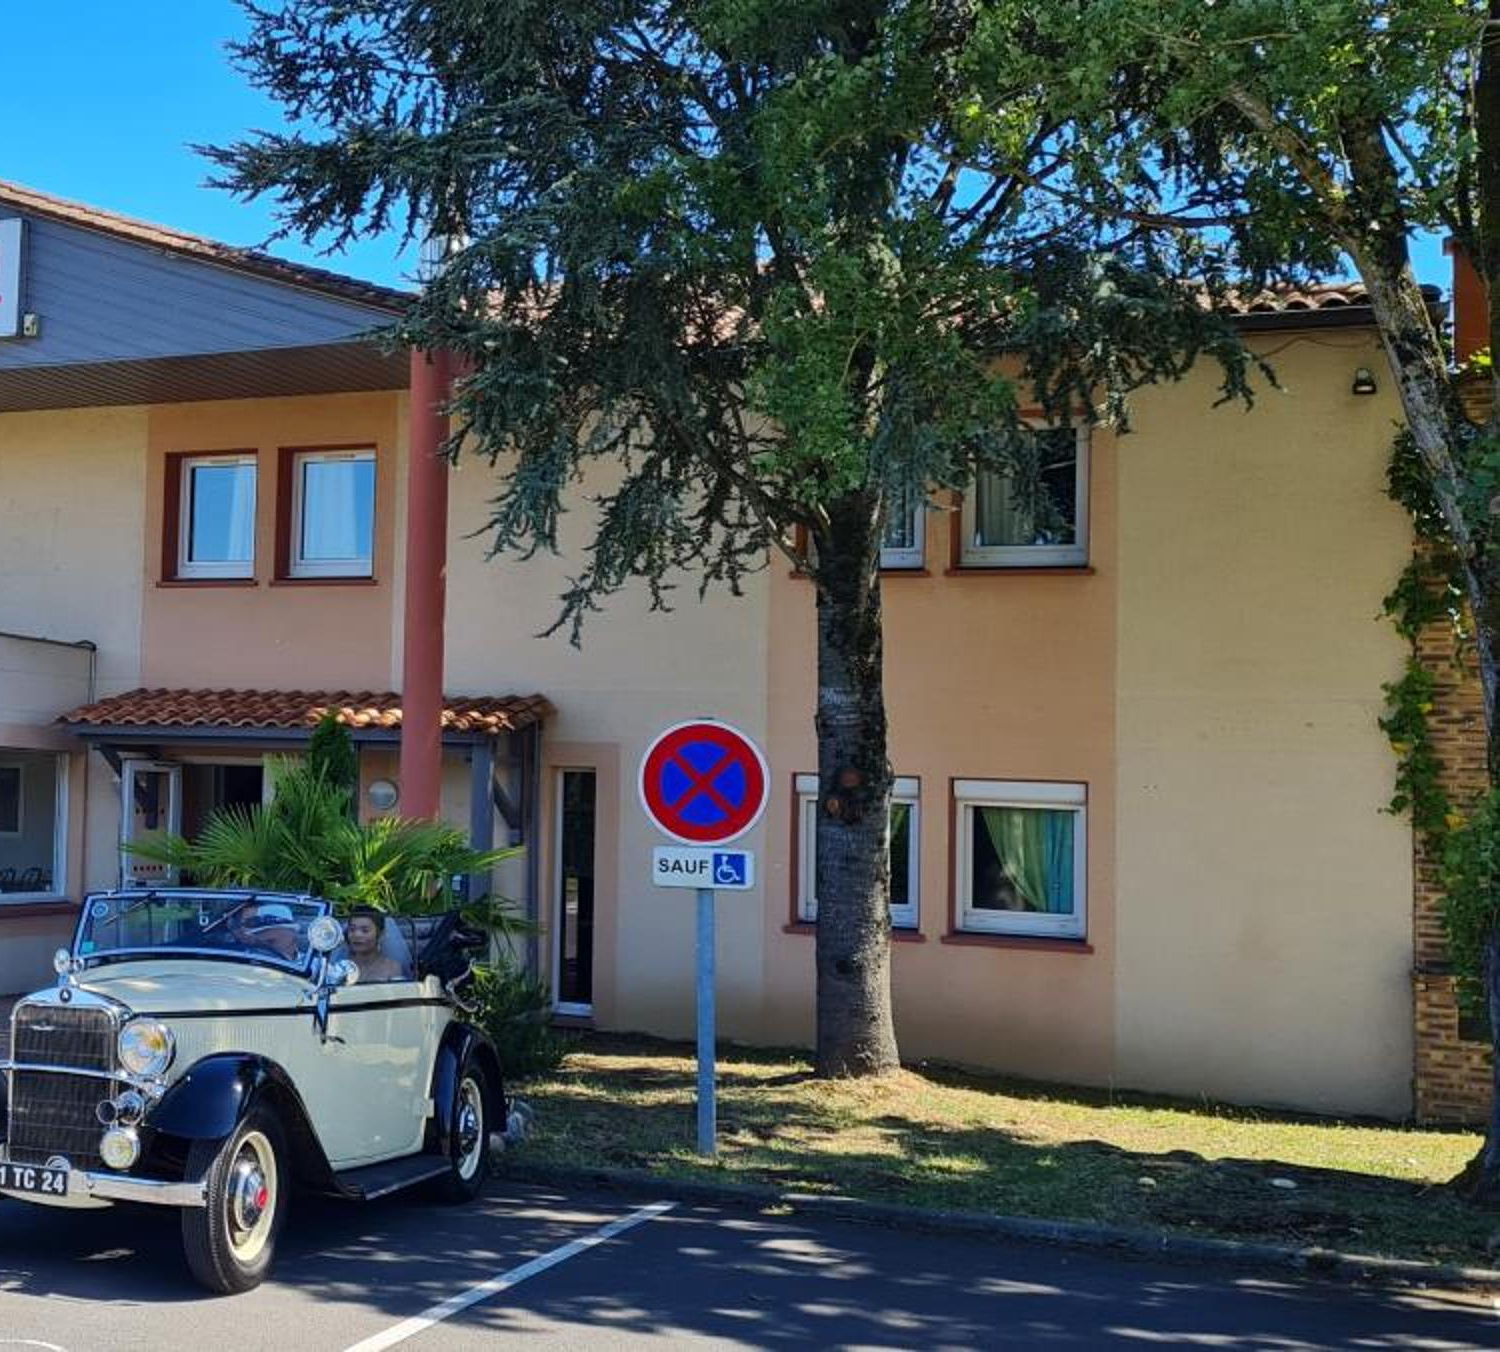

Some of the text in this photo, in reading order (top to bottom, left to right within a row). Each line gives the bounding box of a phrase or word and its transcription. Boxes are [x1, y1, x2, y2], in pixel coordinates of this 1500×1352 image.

[658, 857, 709, 875] SAUF
[12, 1166, 36, 1189] TC
[41, 1170, 64, 1193] 24
